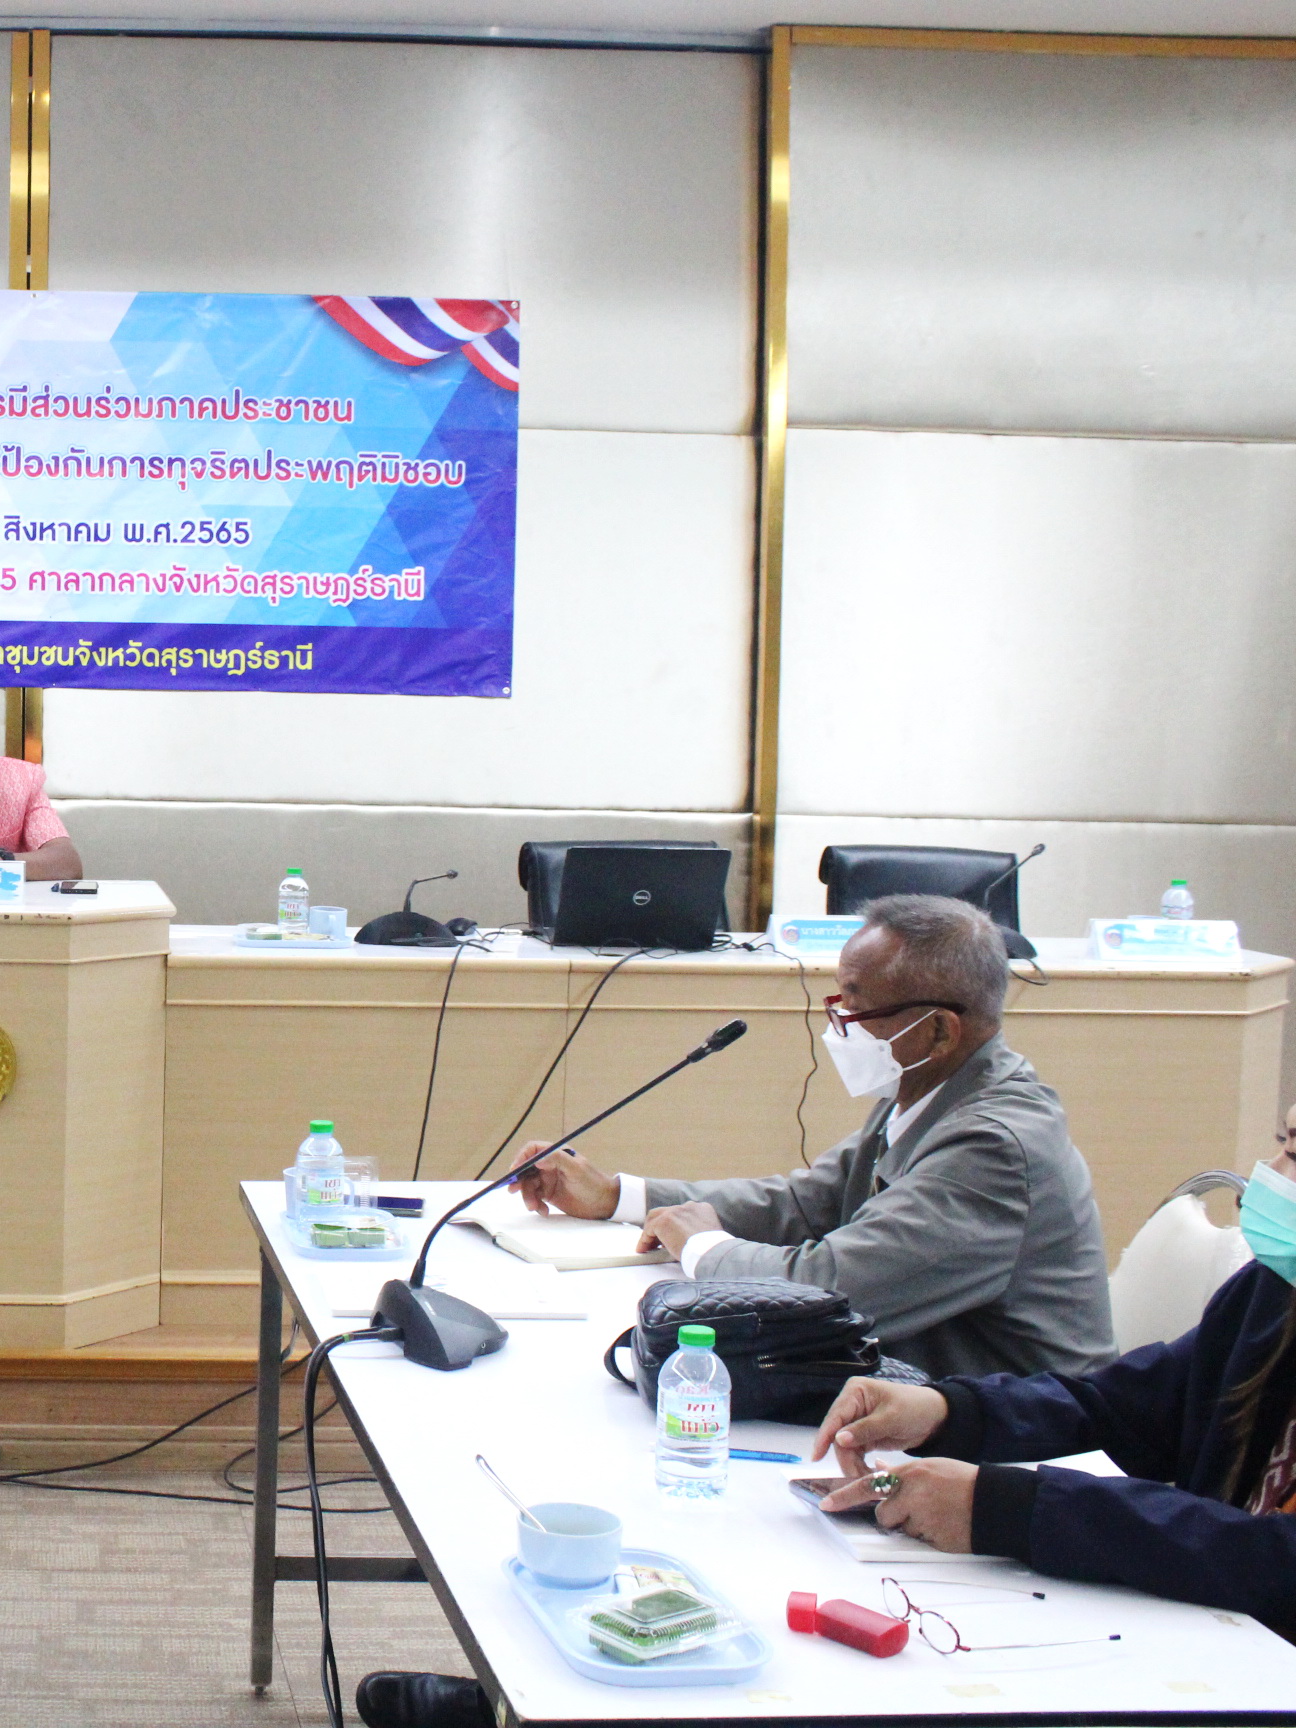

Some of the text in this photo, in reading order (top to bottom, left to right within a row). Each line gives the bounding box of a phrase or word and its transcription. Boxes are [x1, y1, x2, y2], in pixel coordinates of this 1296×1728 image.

[3, 515, 112, 543] สิงหาคม
[123, 519, 251, 545] พ.ศ.2565
[0, 567, 17, 591] 5
[28, 565, 423, 605] ศาลากลางจังหวัดสุราษฎร์ธานี
